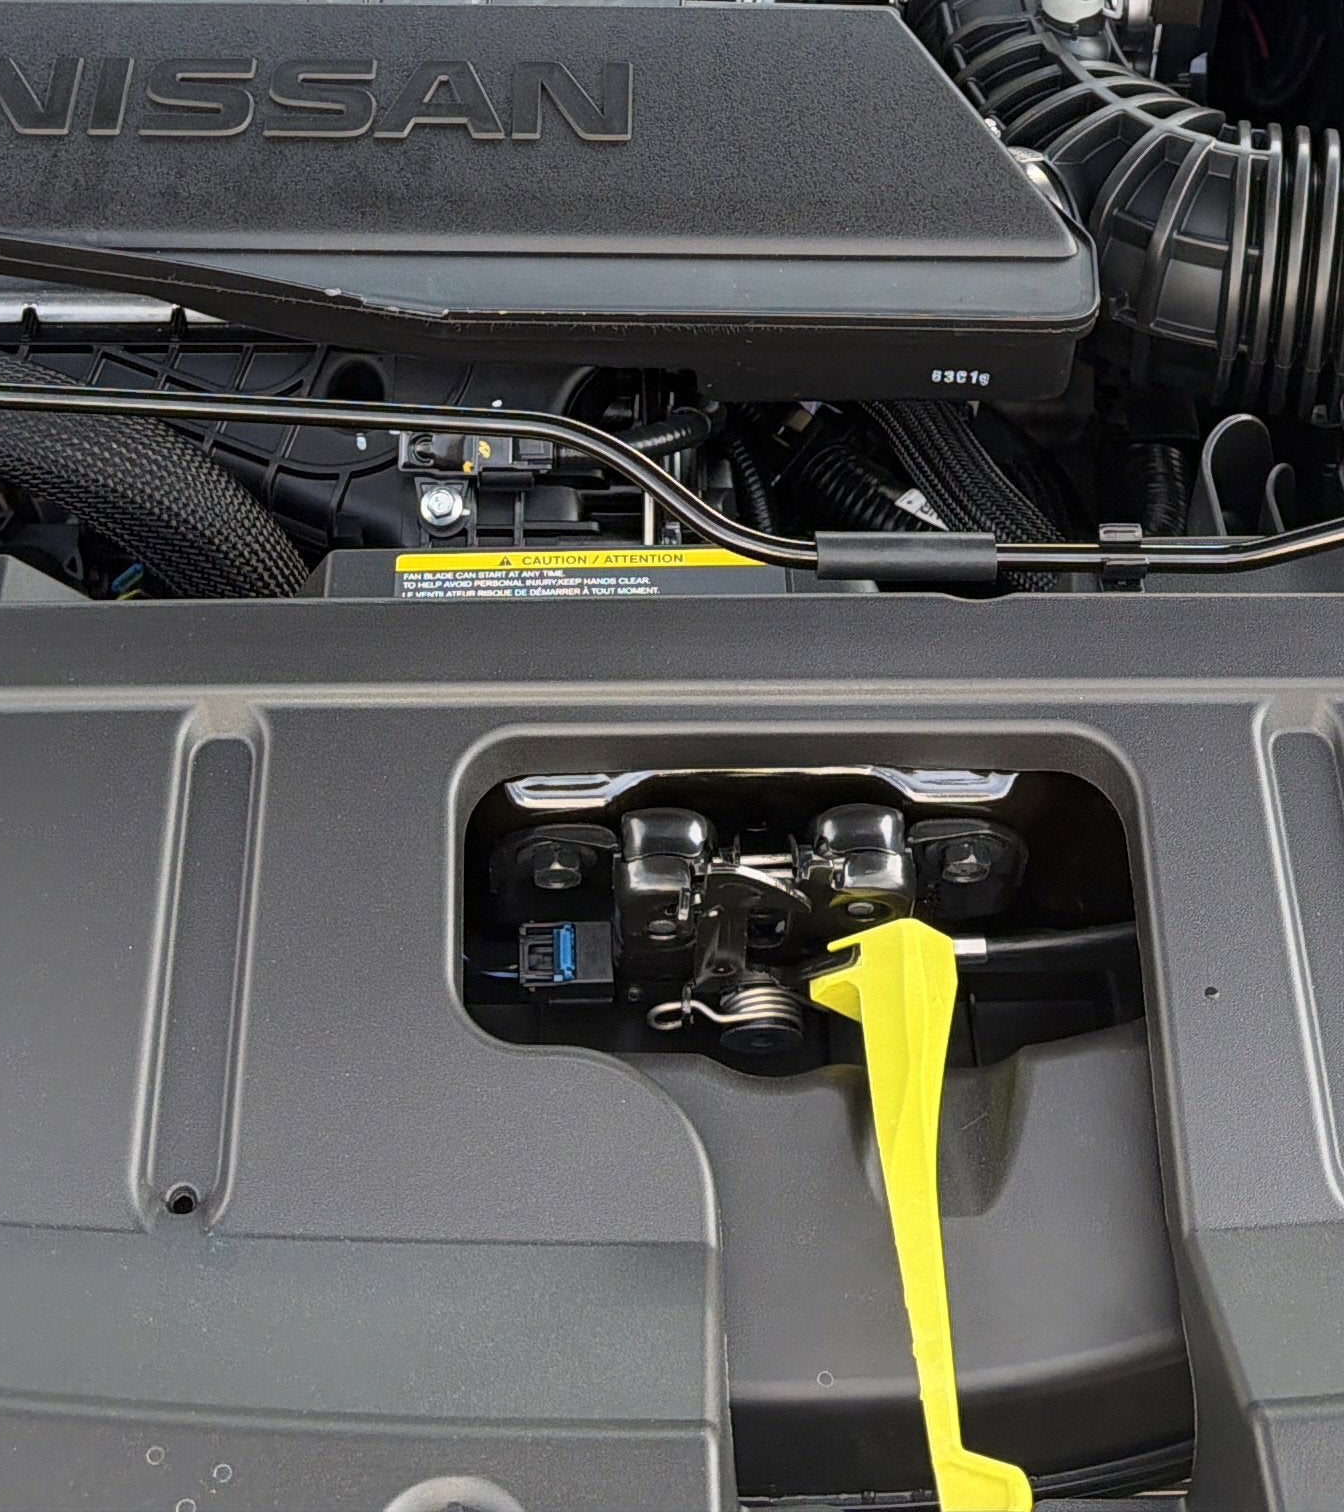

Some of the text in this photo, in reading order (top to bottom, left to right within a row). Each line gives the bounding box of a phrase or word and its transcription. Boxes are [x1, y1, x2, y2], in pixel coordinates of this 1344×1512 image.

[521, 554, 587, 566] CAUTION
[604, 553, 684, 565] ATTENTION
[403, 569, 566, 581] FAN BLADE CAN START AT ANY TIME.
[402, 580, 416, 589] TO
[417, 580, 443, 589] HELP
[443, 580, 472, 589] AVOID
[474, 579, 525, 588] PERSONAL
[583, 577, 617, 586] HANDS
[476, 588, 513, 598] RISQUE
[514, 588, 528, 597] DE
[529, 586, 581, 597] DÉMARRER
[591, 587, 617, 596] TOUT
